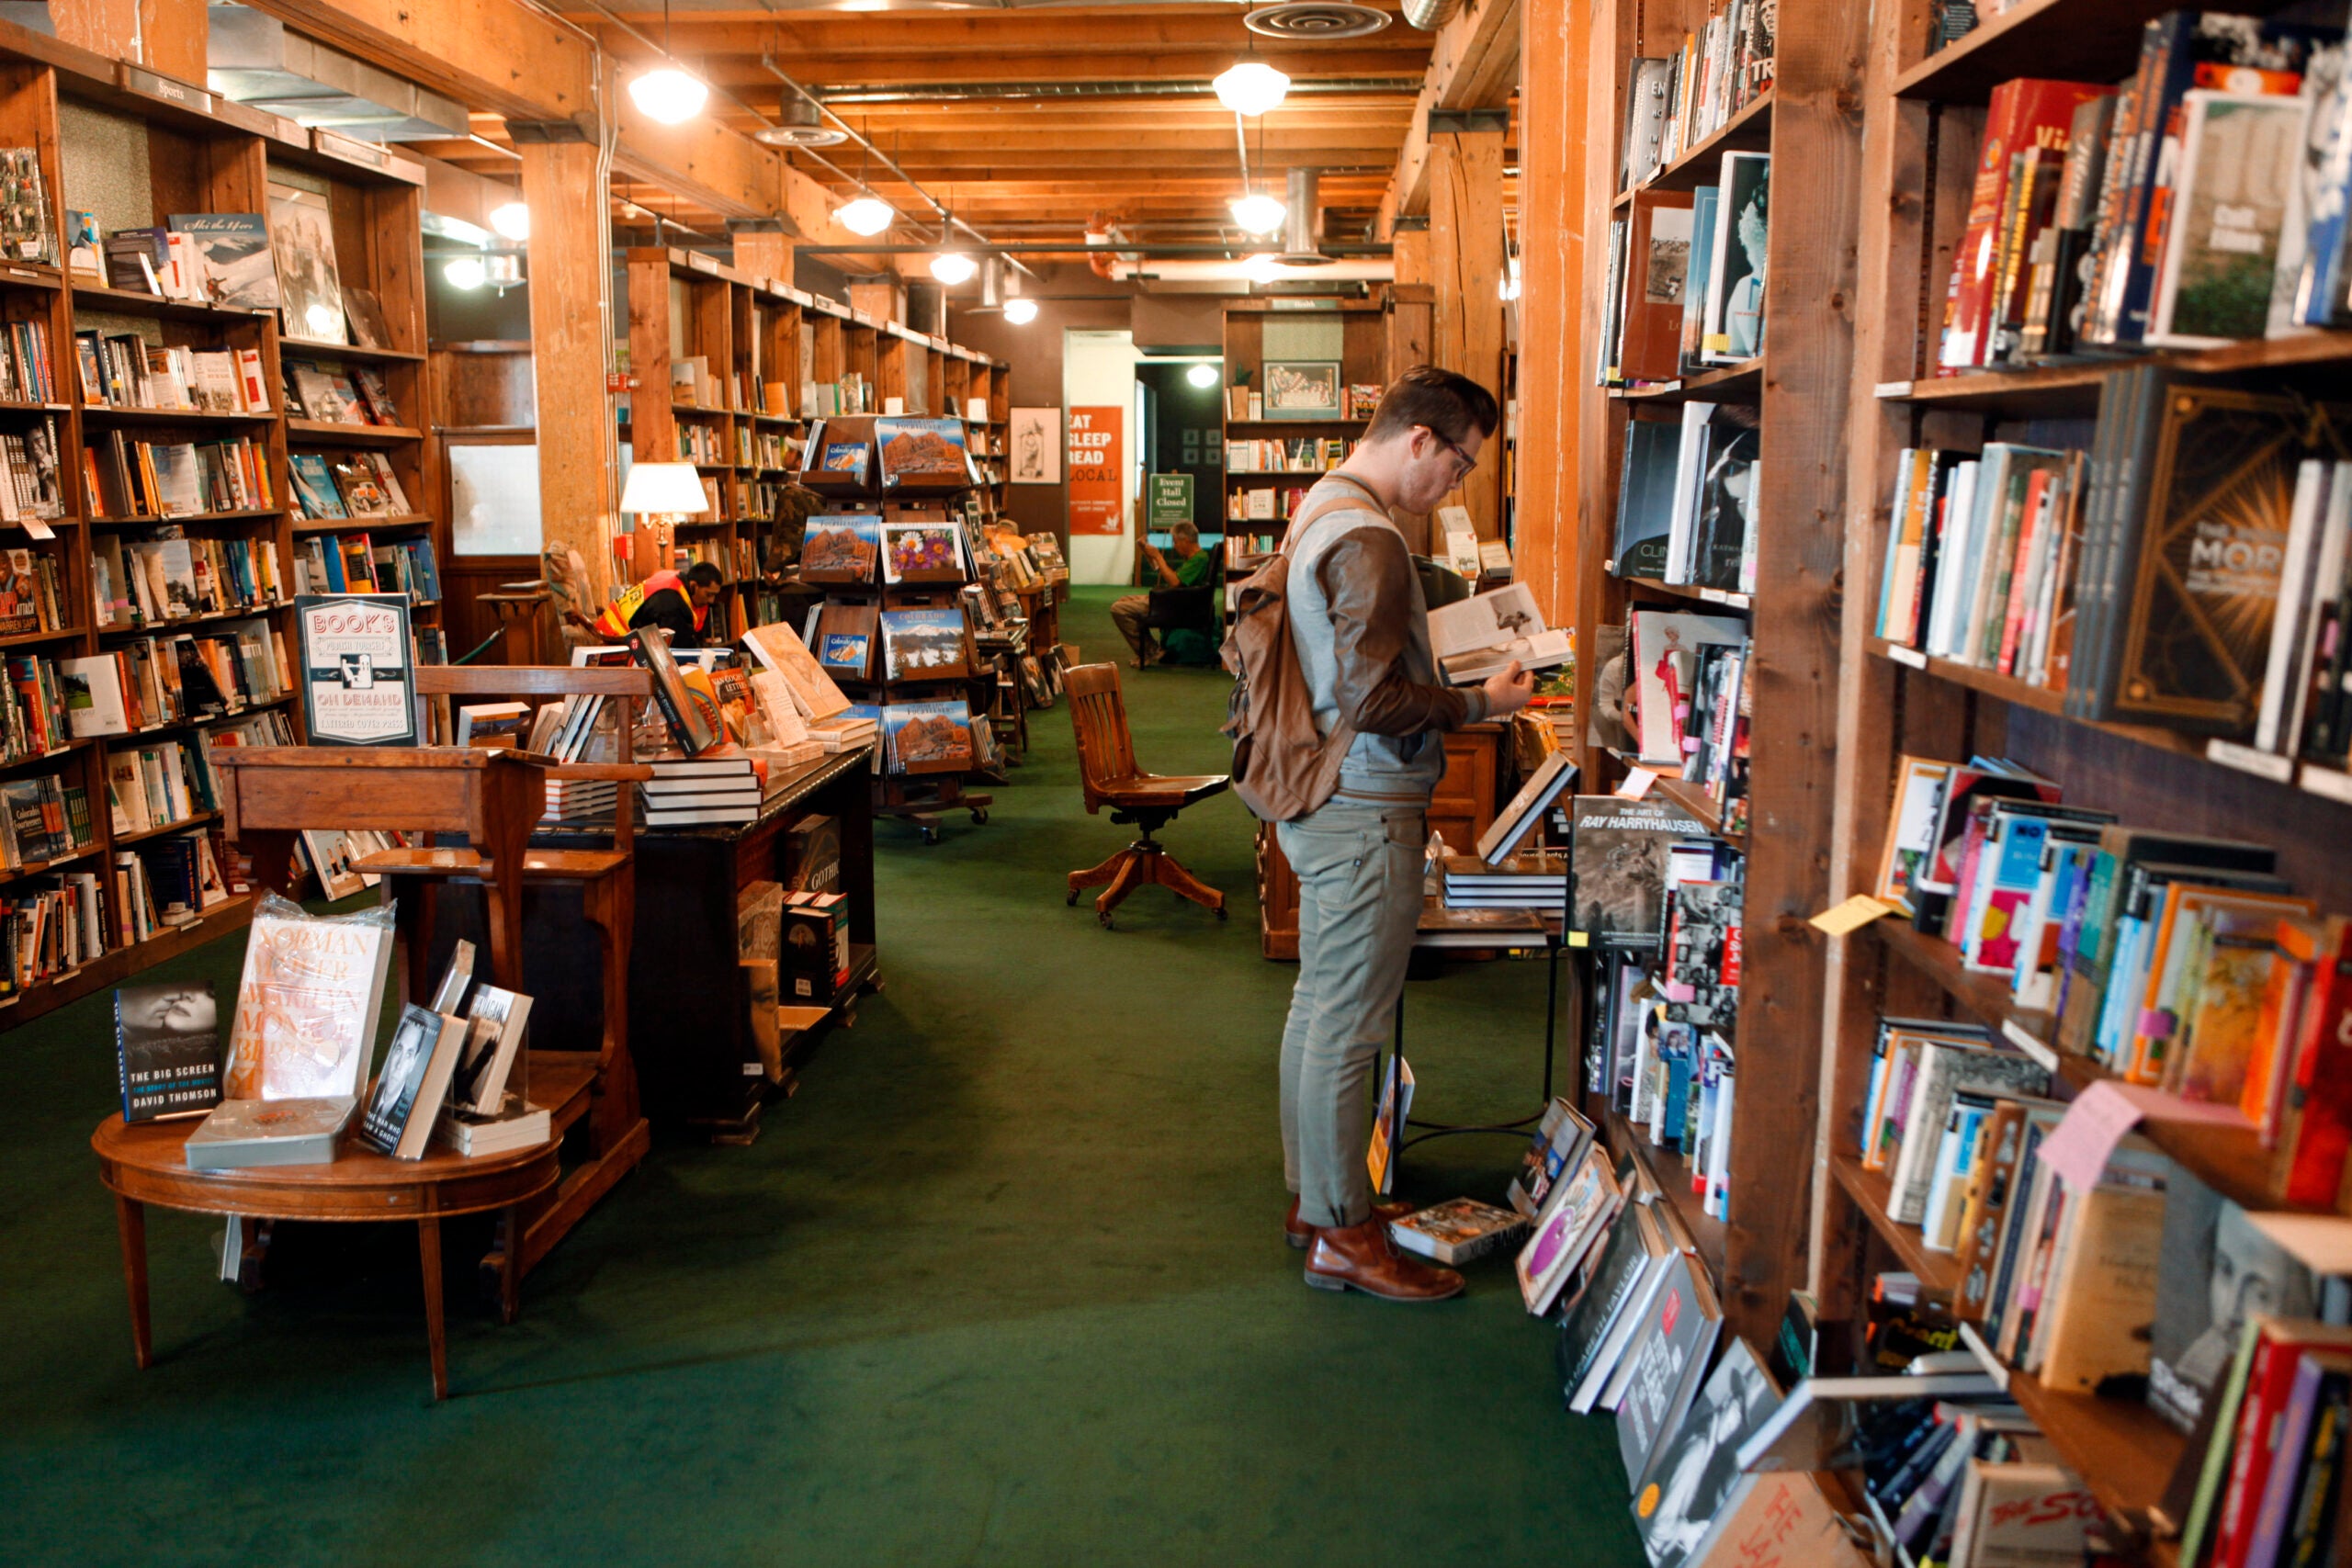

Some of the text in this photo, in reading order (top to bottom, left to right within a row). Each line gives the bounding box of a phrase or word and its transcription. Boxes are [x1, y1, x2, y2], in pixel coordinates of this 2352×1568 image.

[158, 81, 185, 100] Sports
[185, 219, 210, 231] Ski
[210, 219, 225, 230] the
[1159, 478, 1184, 487] Event
[1162, 487, 1182, 496] Hall
[1156, 497, 1187, 506] Closed
[899, 613, 946, 621] COLORADO
[313, 614, 395, 634] BOOKS
[326, 641, 385, 651] PUBLISH YOURSELF
[711, 676, 727, 685] VAN
[317, 694, 402, 706] ON DEMAND
[321, 719, 404, 728] TATTERED COVER PRESS
[1619, 807, 1635, 816] THE
[1636, 808, 1652, 817] ART
[1579, 816, 1706, 834] RAY HARRYHAUSEN
[130, 1064, 215, 1083] THE BIG SCREEN
[133, 1089, 217, 1109] DAVID THOMSON
[378, 1115, 389, 1129] MAN
[388, 1121, 401, 1134] WHO
[378, 1129, 398, 1143] GHOST
[1607, 1255, 1638, 1312] TAYLOR
